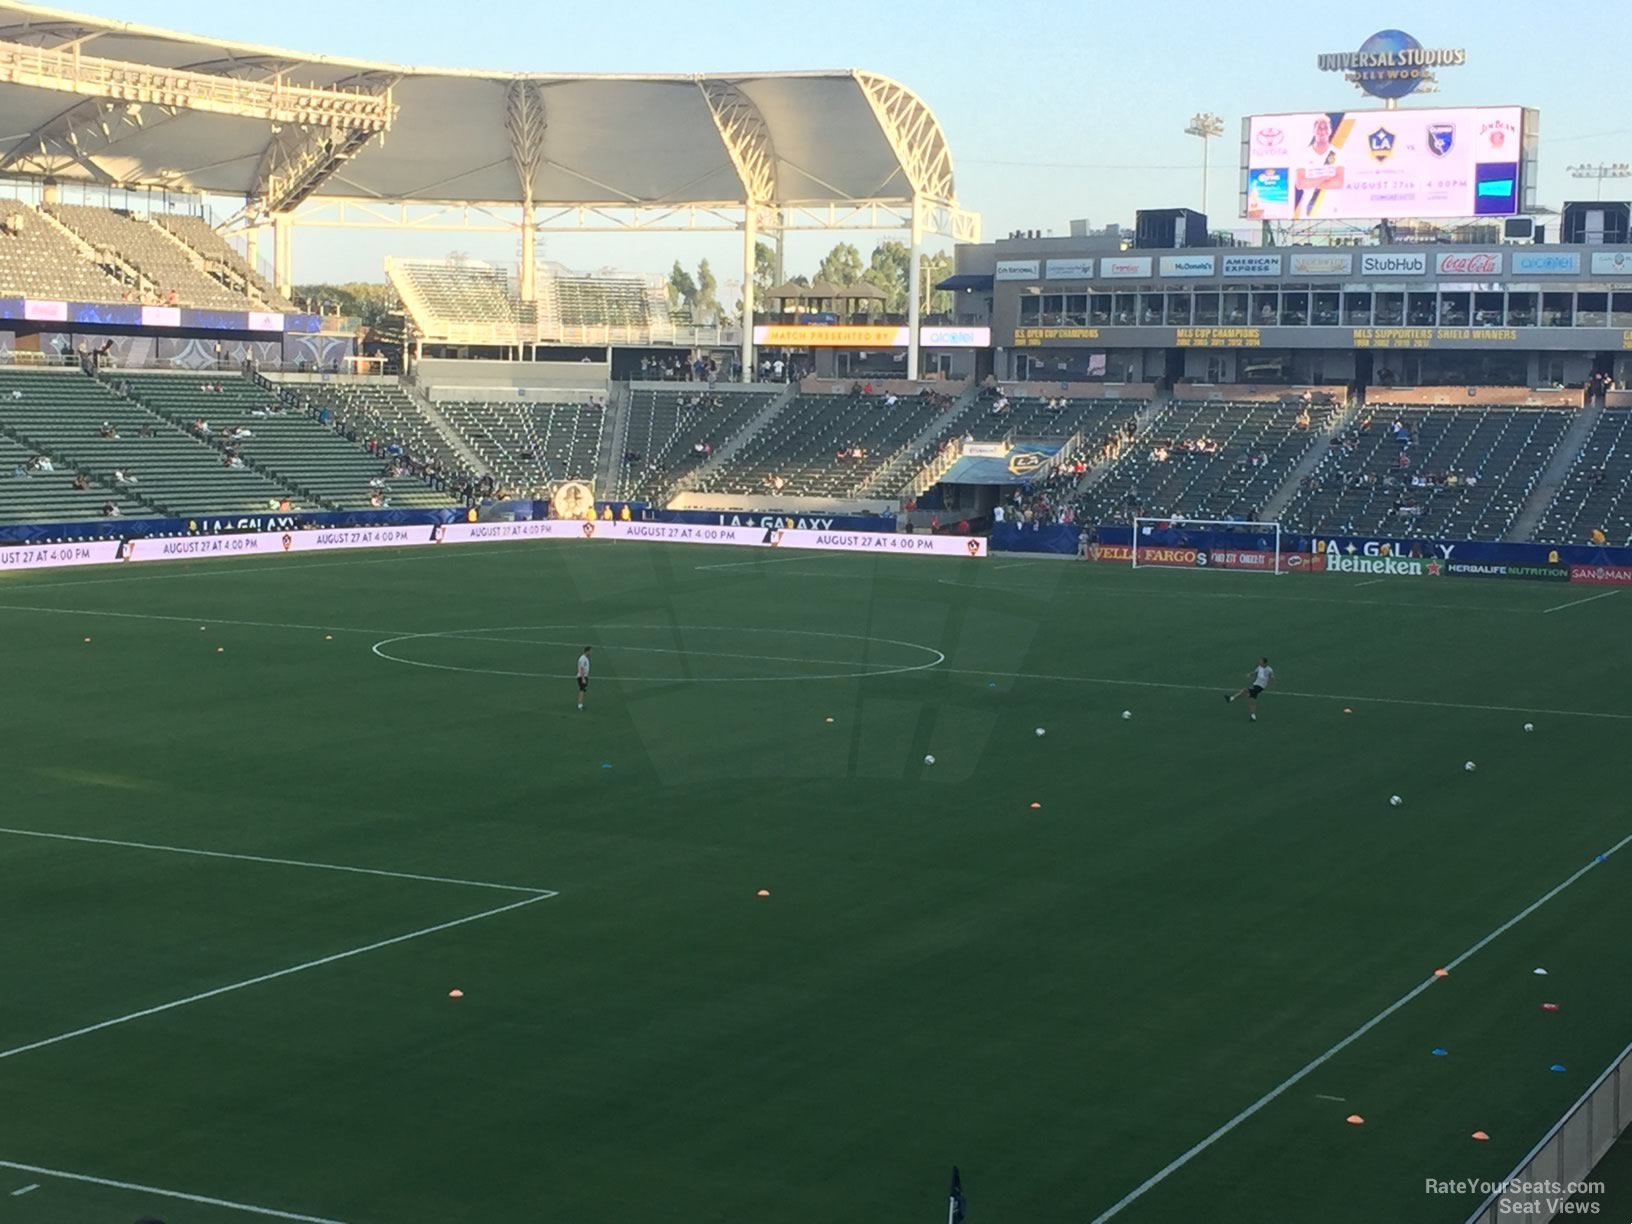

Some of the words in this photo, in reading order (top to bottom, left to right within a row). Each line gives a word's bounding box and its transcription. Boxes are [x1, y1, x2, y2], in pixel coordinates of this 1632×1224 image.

[1317, 51, 1396, 71] UNIVERSAL
[1398, 48, 1465, 67] STUDIOS
[1372, 138, 1390, 149] LA
[1346, 181, 1388, 190] AUGUST
[1175, 262, 1212, 271] McDonald's
[1364, 257, 1423, 271] StubHub
[771, 331, 806, 340] MATCH
[810, 332, 871, 340] PRESENTED
[876, 332, 889, 340] BY
[1177, 329, 1193, 338] MLS
[1195, 329, 1211, 338] CUP
[1212, 329, 1260, 338] CHAMPIONS
[1353, 329, 1373, 339] MLS
[1375, 329, 1433, 339] SUPPORTERS
[1437, 330, 1470, 339] SHIELD
[1472, 330, 1517, 340] WINNERS
[761, 516, 834, 530] GAAXY
[317, 533, 349, 544] AUGUST
[351, 533, 360, 543] 27
[362, 532, 372, 541] AT
[395, 531, 408, 540] PM
[471, 527, 500, 537] AUGUST
[627, 527, 665, 537] AUGUST
[668, 528, 678, 537] 27
[681, 528, 693, 538] AT
[720, 530, 735, 539] PM
[163, 541, 199, 554] AUGUST
[201, 541, 210, 552] 27
[212, 540, 223, 550] AT
[245, 539, 258, 548] PM
[816, 535, 858, 546] AUGUST
[861, 537, 872, 546] 27
[875, 538, 887, 547] AT
[917, 539, 933, 549] PM
[1, 552, 20, 564] UST
[23, 550, 33, 563] 27
[36, 550, 48, 561] AT
[75, 548, 90, 559] PM
[1144, 549, 1197, 562] FARGO
[1363, 541, 1455, 560] GLY
[1326, 555, 1422, 575] Heineken
[1449, 564, 1507, 574] HERBALIFE
[1508, 566, 1568, 577] NUTRITION
